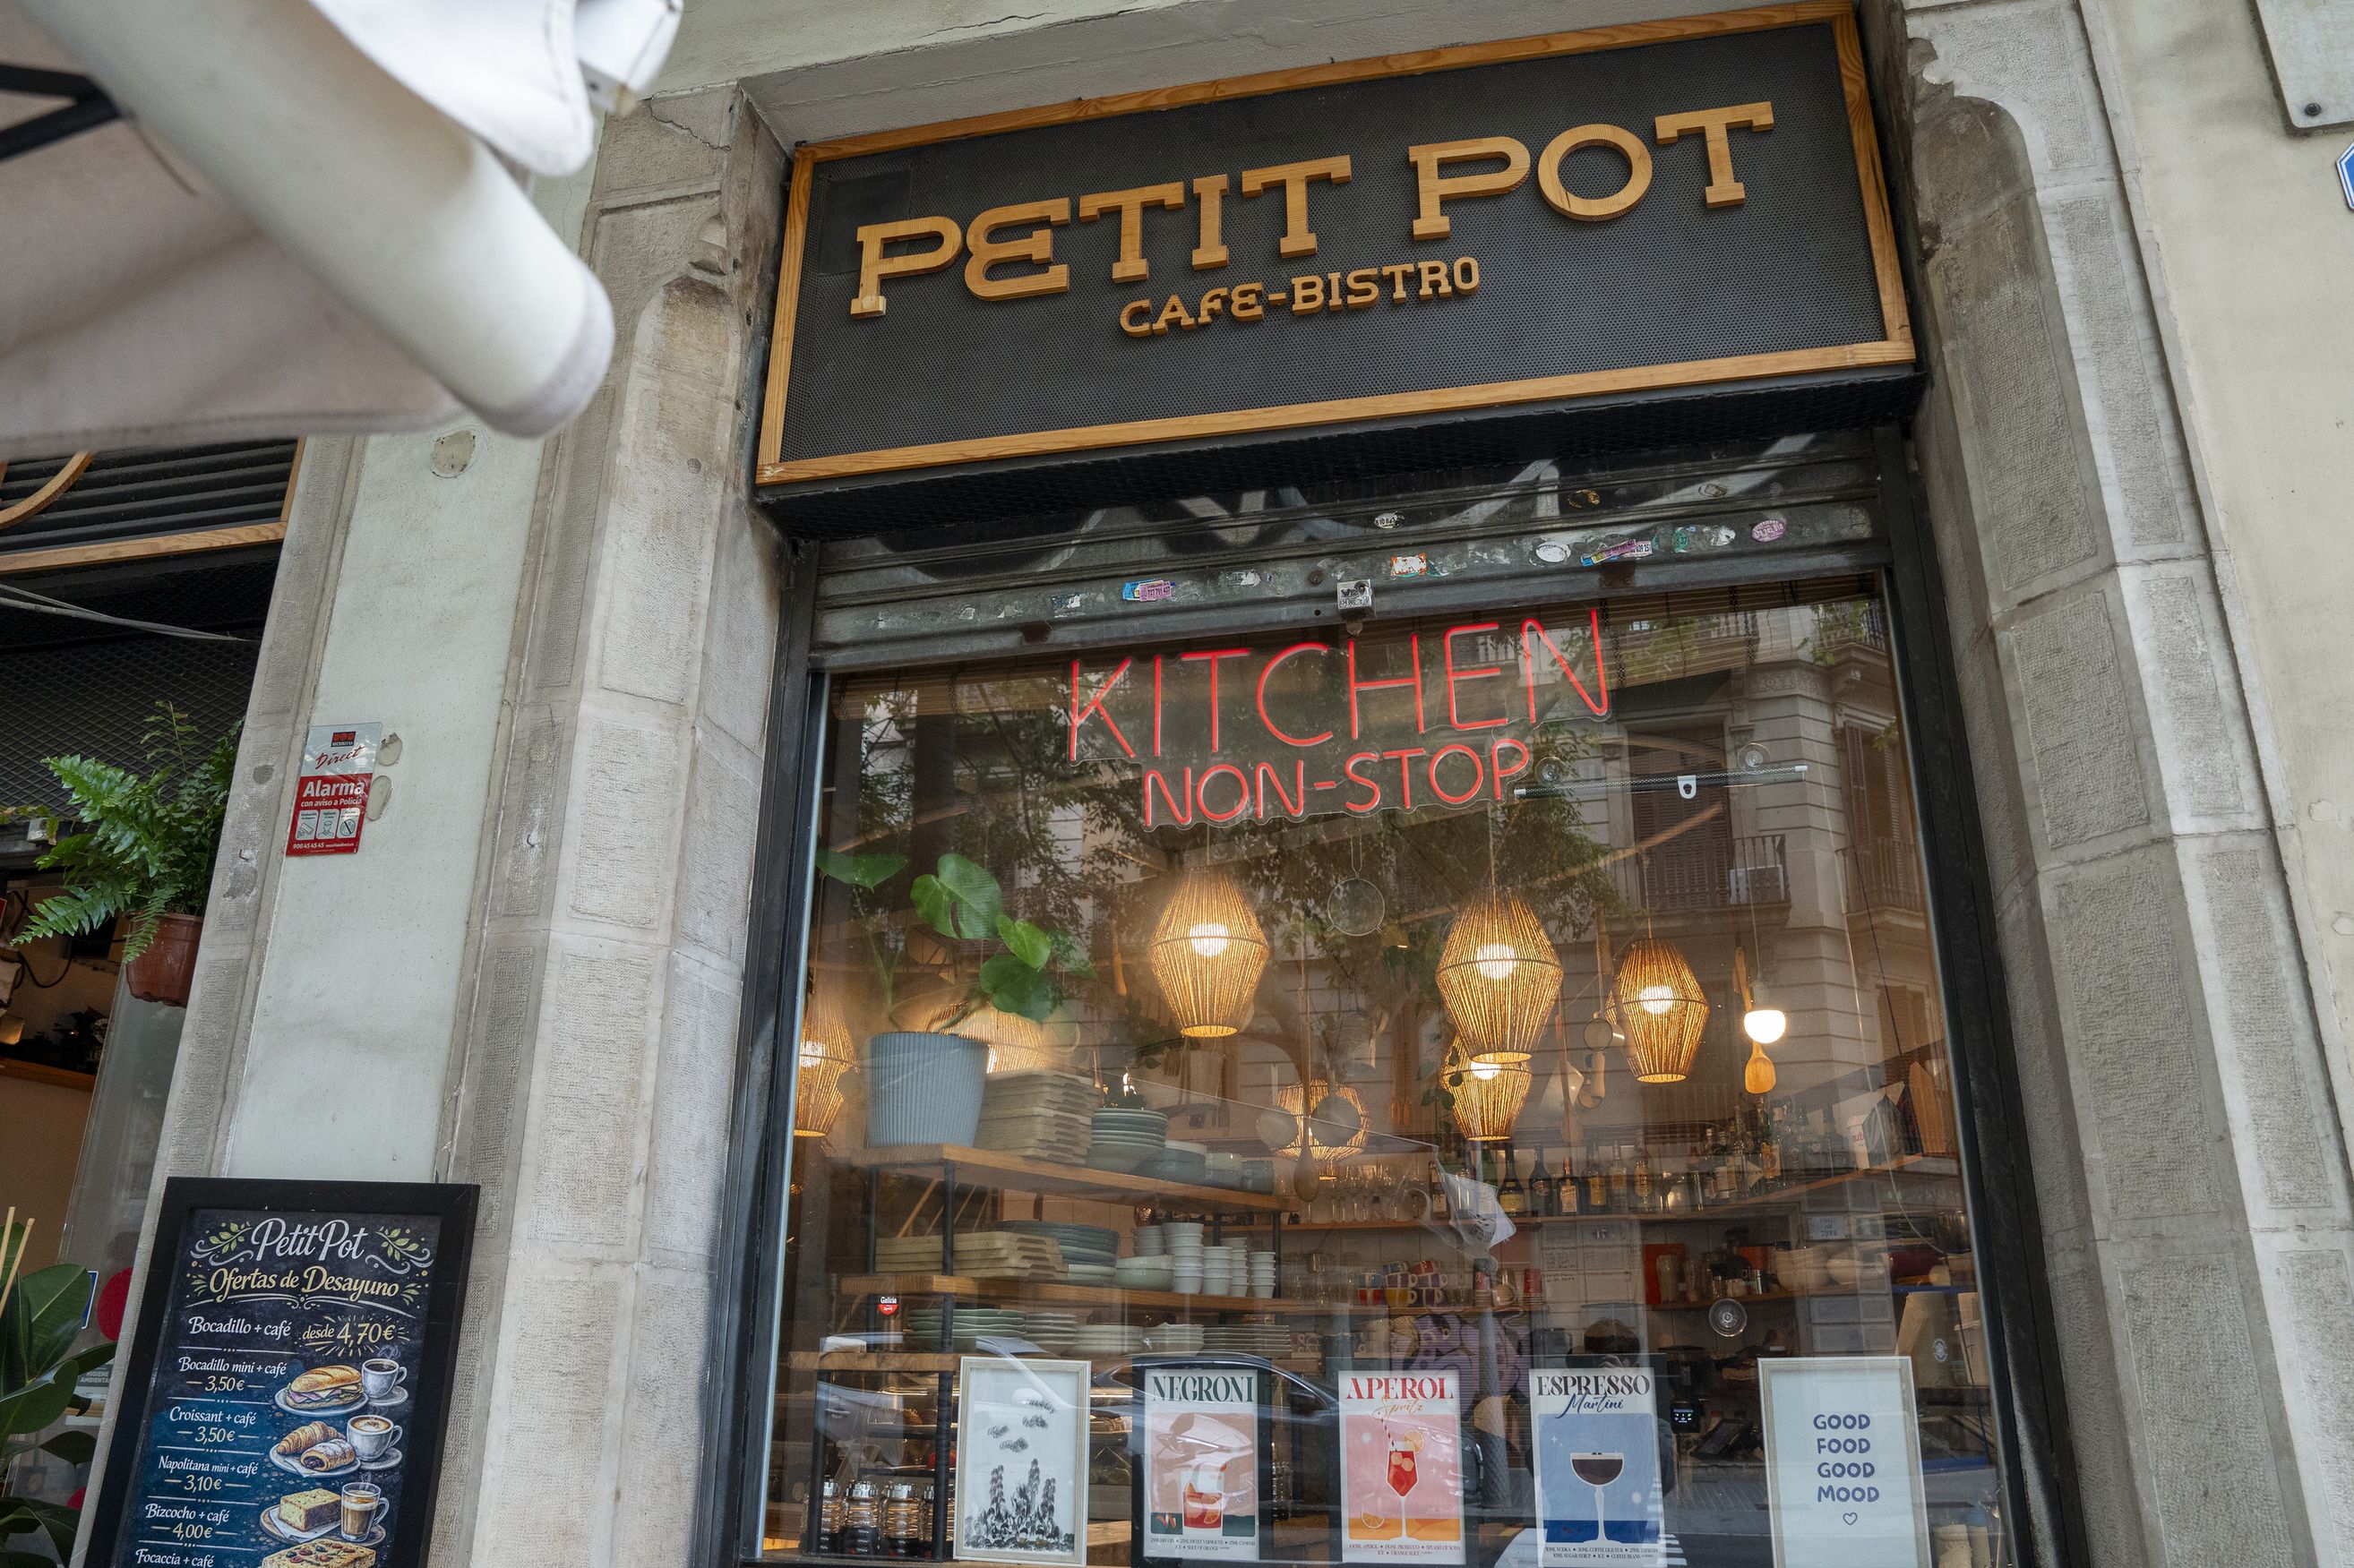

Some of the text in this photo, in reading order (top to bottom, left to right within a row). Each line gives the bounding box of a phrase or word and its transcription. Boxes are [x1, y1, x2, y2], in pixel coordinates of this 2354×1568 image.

[850, 100, 1774, 318] PETIT POT
[1119, 255, 1482, 339] CAFE-BISTRO
[1070, 608, 1609, 763] KITCHEN
[315, 745, 368, 770] Direct
[303, 779, 365, 798] Alarma
[1144, 738, 1531, 828] NON-STOP
[314, 799, 332, 807] aviso
[339, 797, 362, 806] Policía
[251, 1218, 368, 1261] Petit Pot
[210, 1265, 399, 1303] Ofertas de Desayuno
[188, 1316, 252, 1334] Bocadillo
[263, 1320, 292, 1341] café
[302, 1322, 396, 1348] desde 4,70€
[178, 1356, 229, 1372] Bocadillo
[231, 1362, 255, 1374] mini
[264, 1361, 287, 1378] café
[204, 1375, 245, 1393] 3,50€
[1152, 1375, 1253, 1402] NEGRONI
[1345, 1376, 1455, 1400] APEROL
[1536, 1375, 1650, 1396] ESPRESSO
[1372, 1394, 1424, 1418] Spritz
[1555, 1392, 1624, 1418] Martini
[169, 1406, 222, 1423] Croissant
[234, 1411, 256, 1428] café
[1813, 1414, 1870, 1430] GOOD
[194, 1426, 236, 1444] 3,50€
[1817, 1437, 1870, 1454] FOOD
[158, 1455, 210, 1474] Napolitana
[211, 1463, 229, 1473] mini
[236, 1461, 259, 1478] café
[1817, 1461, 1876, 1478] GOOD
[184, 1475, 222, 1493] 3,10€
[1817, 1485, 1880, 1503] MOOD
[145, 1503, 196, 1520] Bizcocho
[207, 1509, 230, 1526] café
[172, 1522, 213, 1540] 4,00€
[191, 1554, 215, 1568] café
